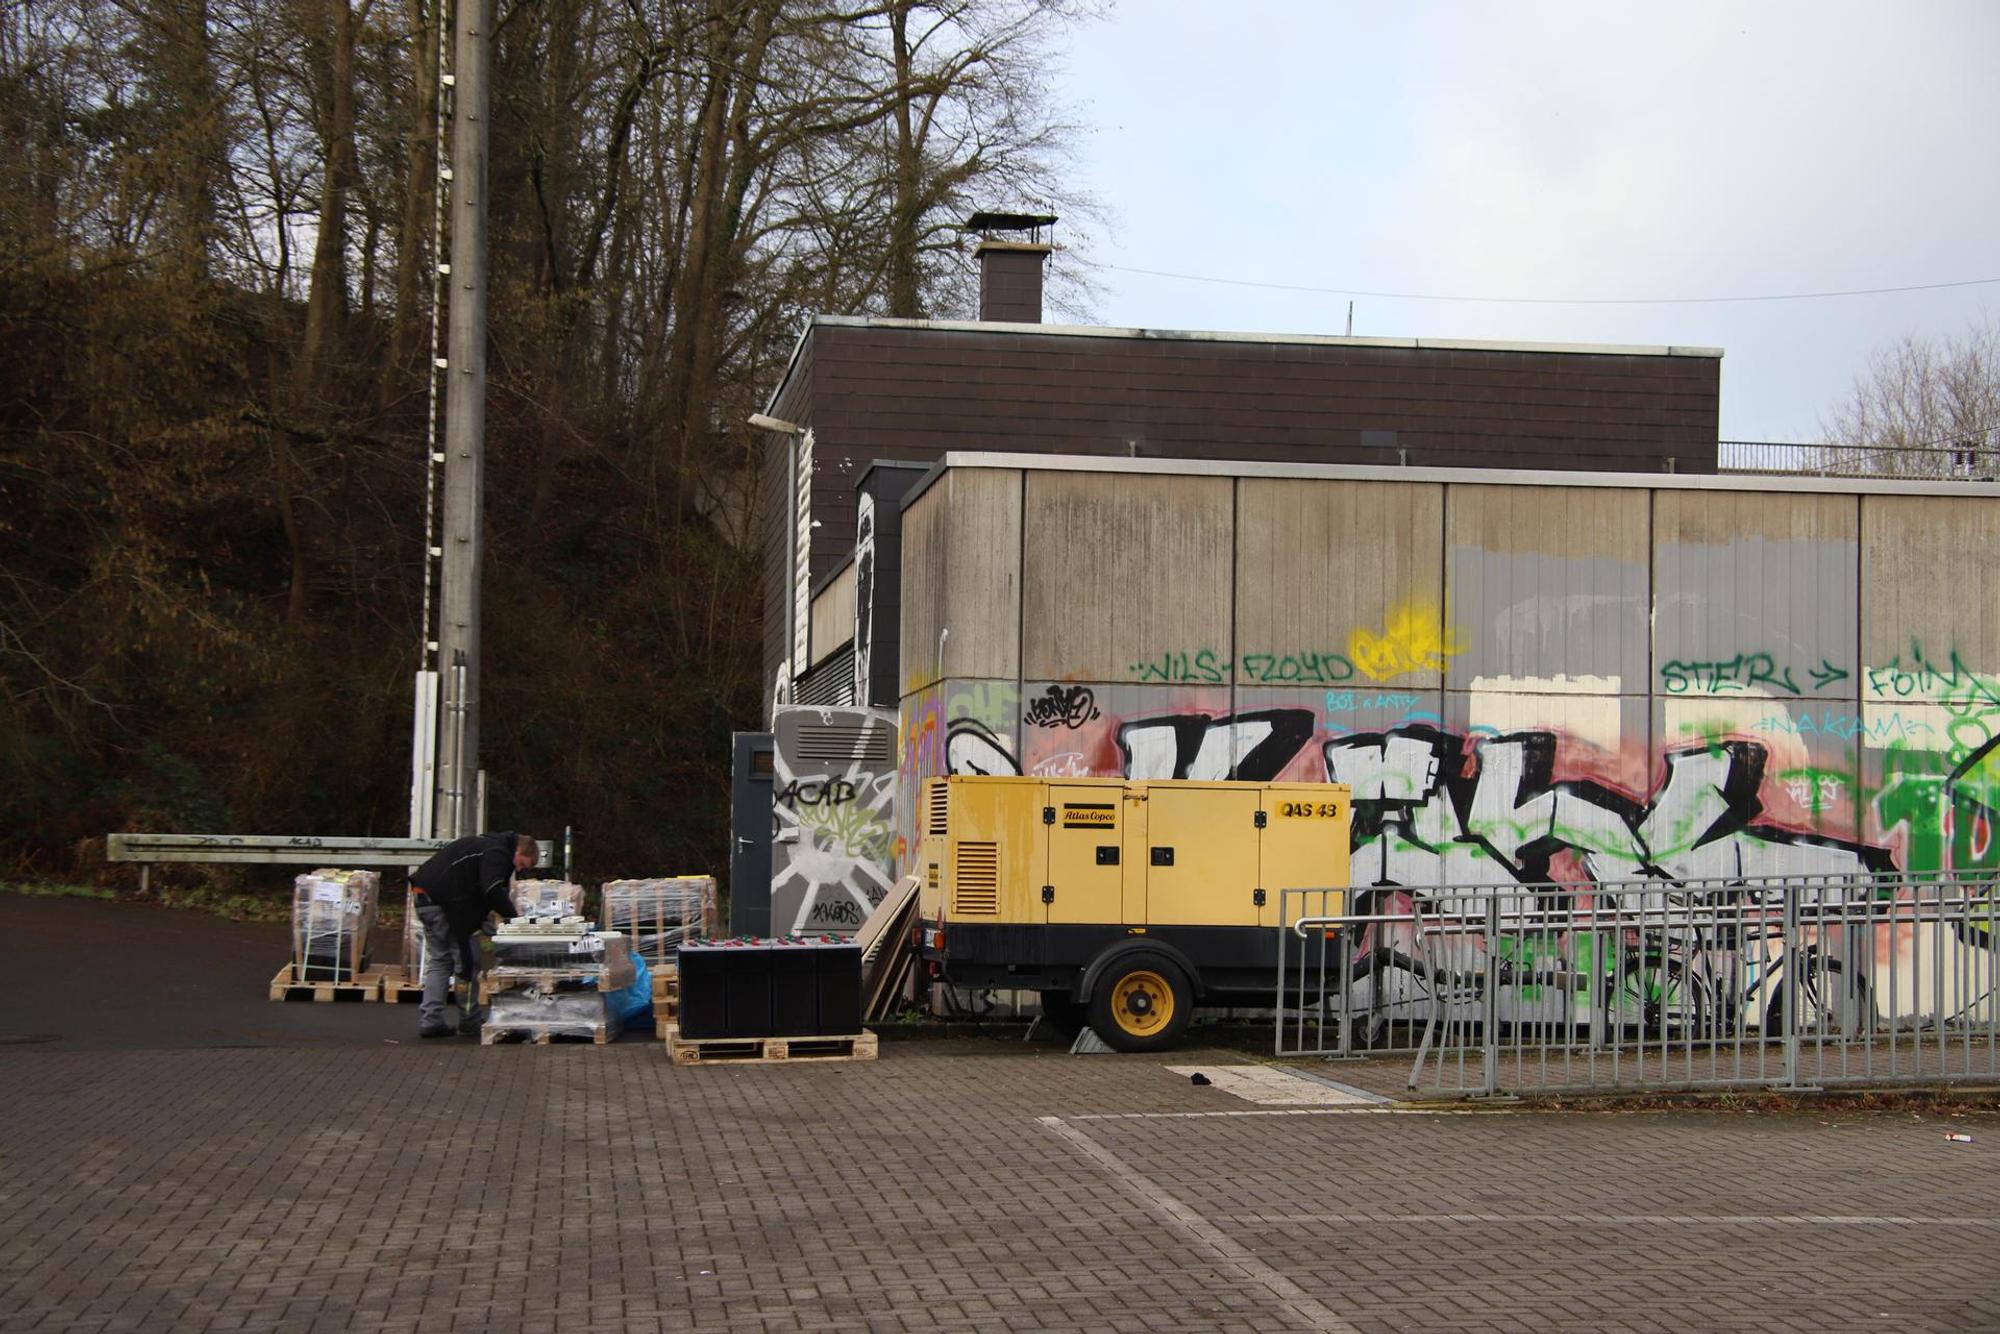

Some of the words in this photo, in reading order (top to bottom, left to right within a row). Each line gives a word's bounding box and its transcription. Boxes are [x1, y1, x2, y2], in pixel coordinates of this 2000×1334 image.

[1063, 810, 1090, 821] Atlas
[1090, 810, 1116, 822] Copco
[1281, 802, 1313, 818] QAS
